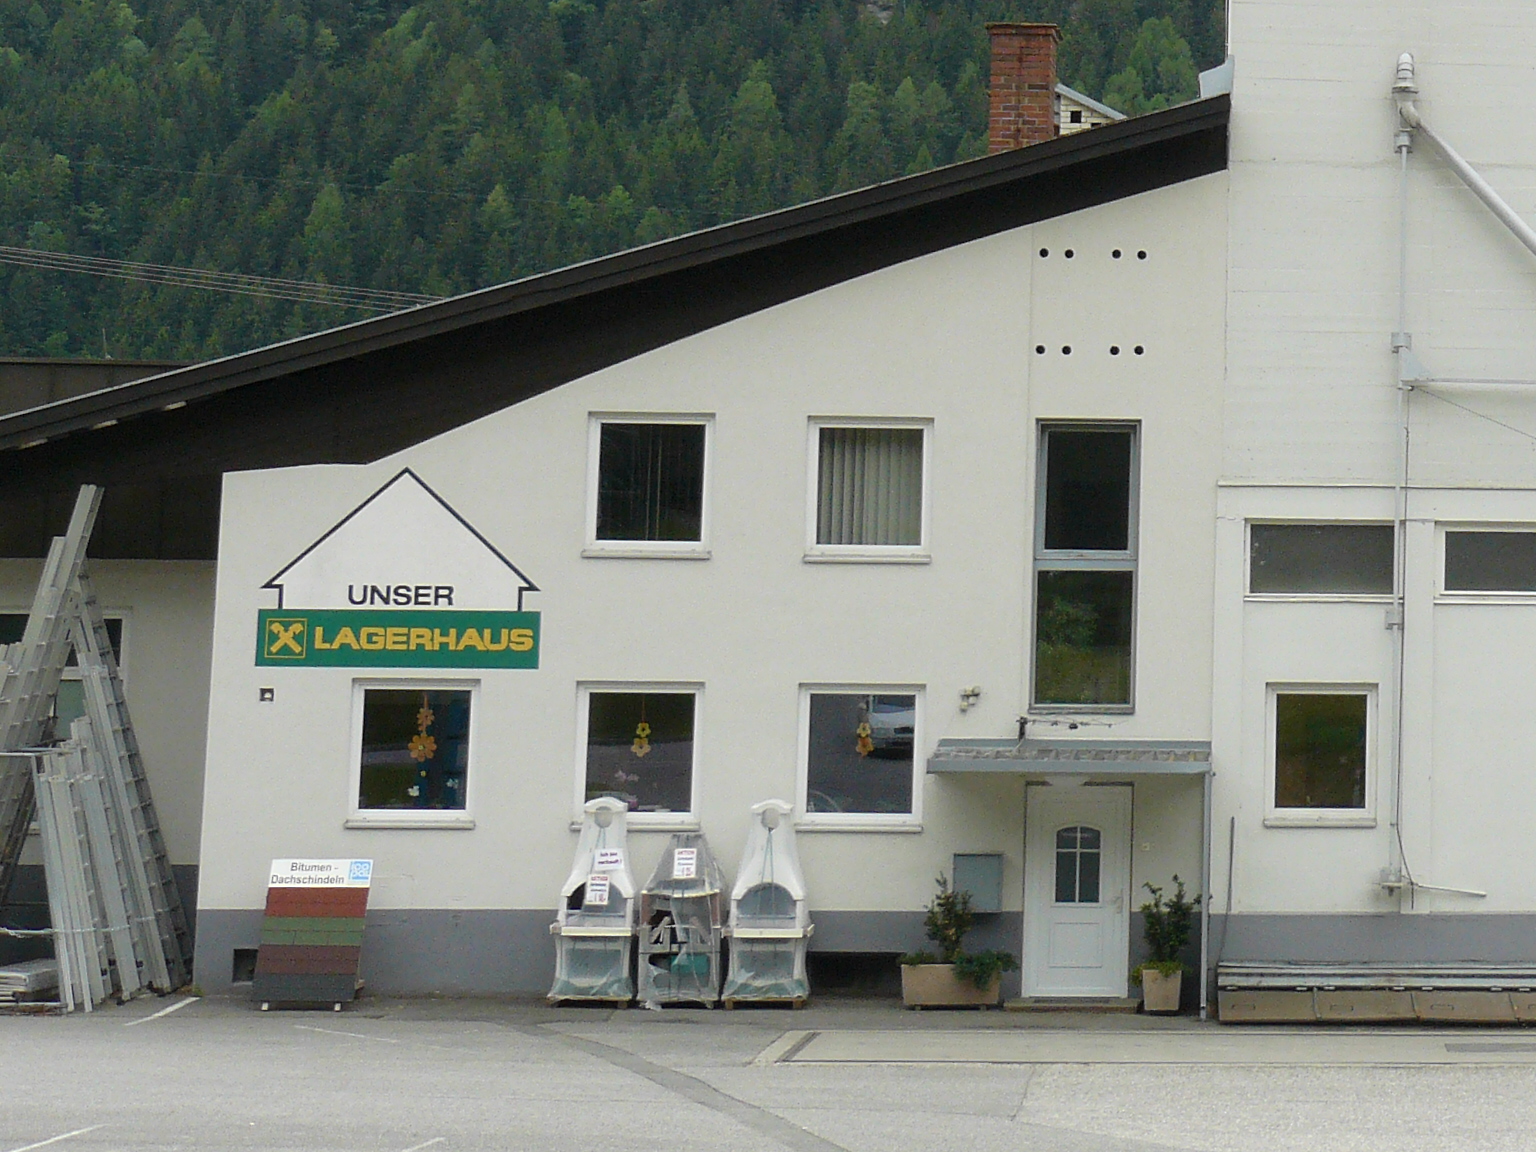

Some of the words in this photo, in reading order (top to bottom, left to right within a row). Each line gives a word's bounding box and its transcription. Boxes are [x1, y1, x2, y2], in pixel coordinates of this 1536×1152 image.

[347, 584, 455, 606] UNSER
[313, 626, 535, 652] LAGERHAUS
[290, 862, 332, 872] Bitumen
[270, 874, 345, 885] Dachschindeln
